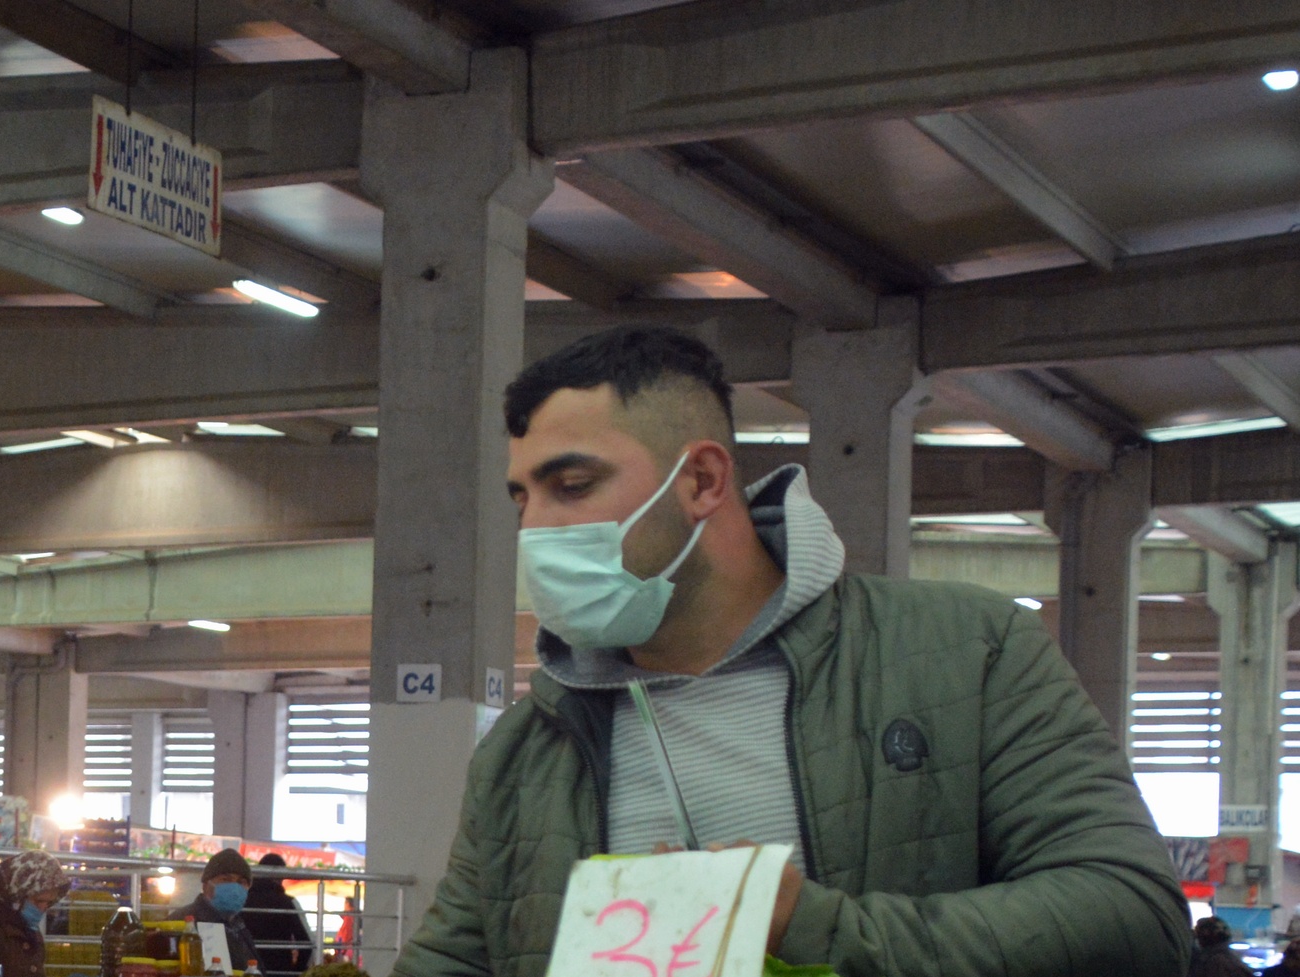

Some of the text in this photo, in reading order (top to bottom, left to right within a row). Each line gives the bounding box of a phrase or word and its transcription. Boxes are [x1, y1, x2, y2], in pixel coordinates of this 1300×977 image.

[107, 176, 207, 245] ALT KATTADIR
[403, 672, 435, 695] C4
[488, 676, 502, 698] C4
